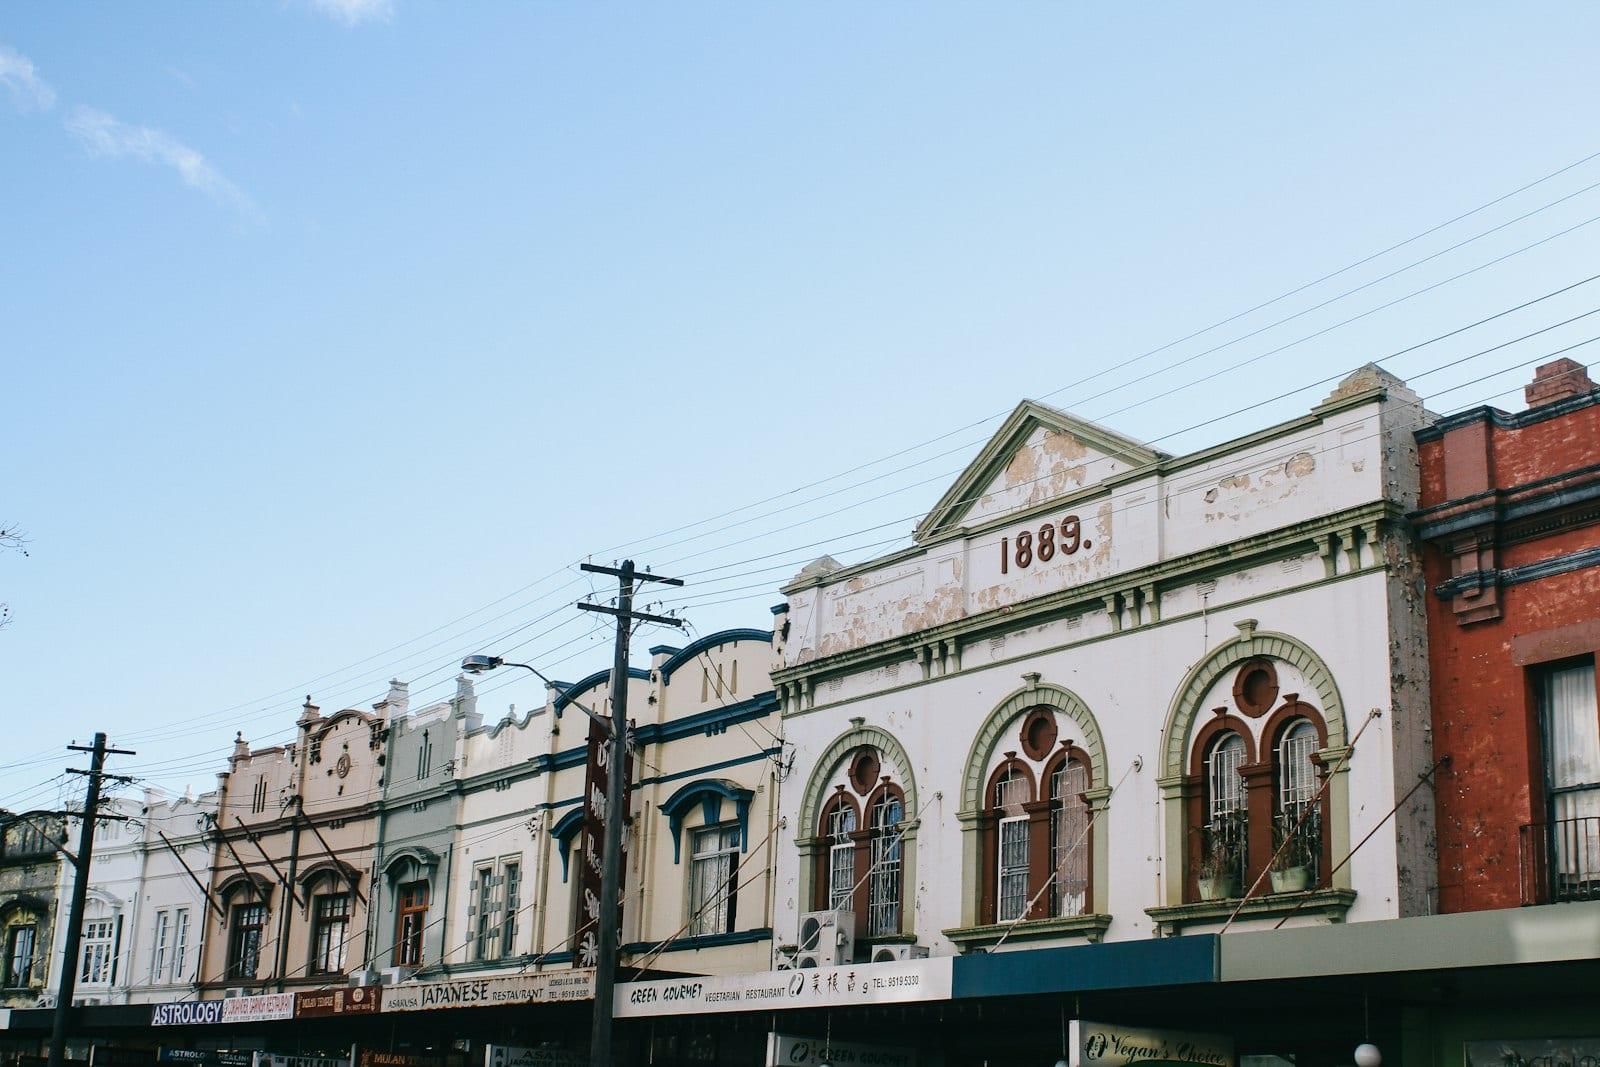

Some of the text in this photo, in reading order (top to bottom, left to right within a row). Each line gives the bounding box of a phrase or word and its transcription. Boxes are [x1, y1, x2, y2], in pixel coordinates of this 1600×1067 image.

[1001, 515, 1092, 575] 1889.
[388, 998, 418, 1009] ASAKUSA
[421, 982, 490, 1007] JAPANESE
[492, 988, 544, 1001] RESTAURANT
[630, 983, 786, 1005] GREEN GOURMET VEGETARIAN RESTAURANT
[153, 1002, 222, 1024] ASTROLOGY
[1111, 1033, 1225, 1064] Vegan's Choice
